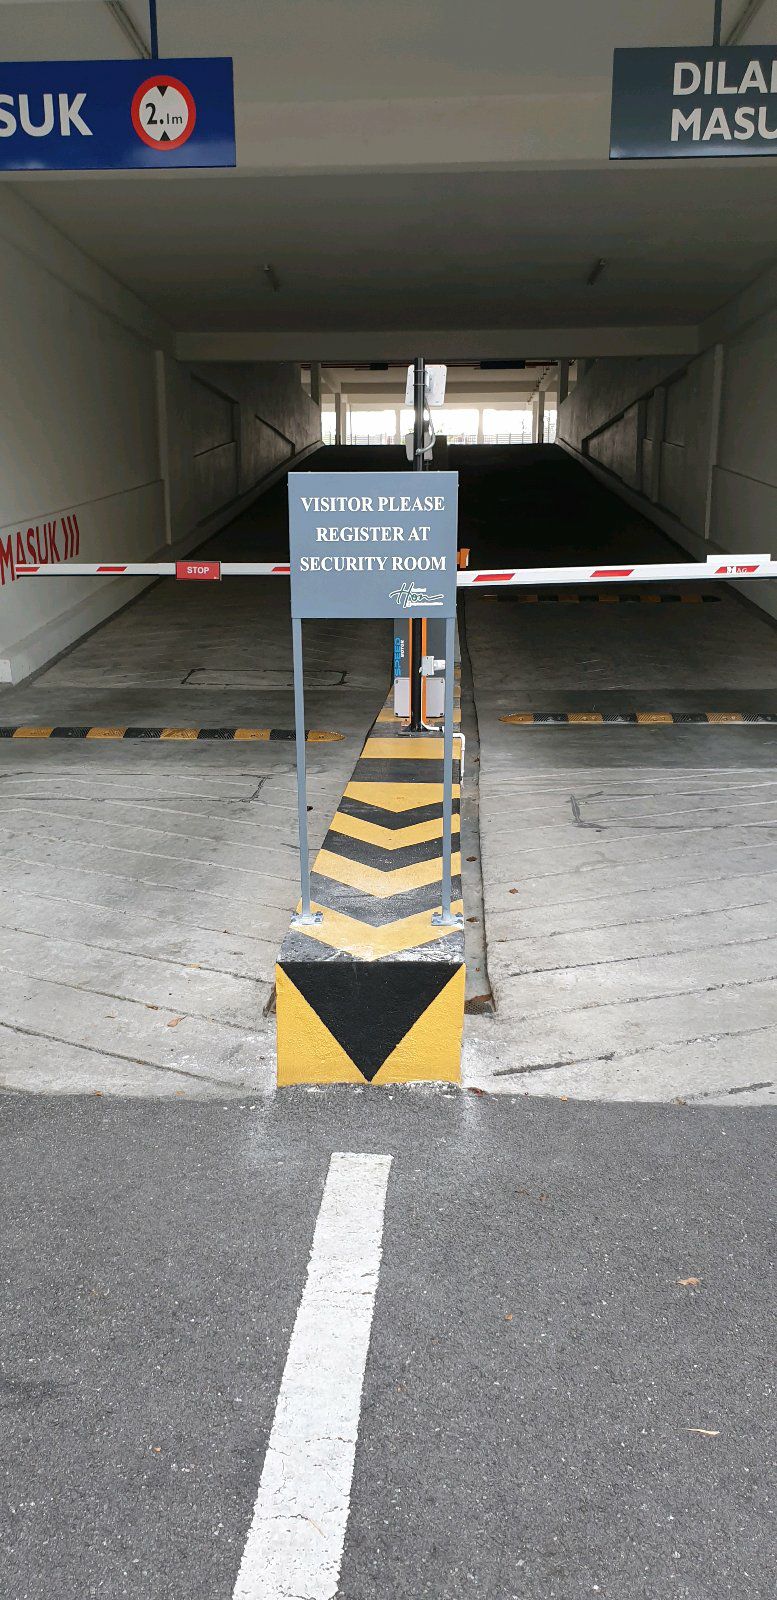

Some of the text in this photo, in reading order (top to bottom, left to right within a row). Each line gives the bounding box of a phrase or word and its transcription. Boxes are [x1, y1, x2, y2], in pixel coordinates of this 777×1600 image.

[673, 60, 777, 95] DILA
[300, 496, 445, 512] VISITOR PLEASE
[315, 526, 431, 542] REGISTER AT
[0, 520, 60, 585] MASUK
[187, 566, 210, 574] STOP
[300, 556, 446, 571] SECURITY ROOM
